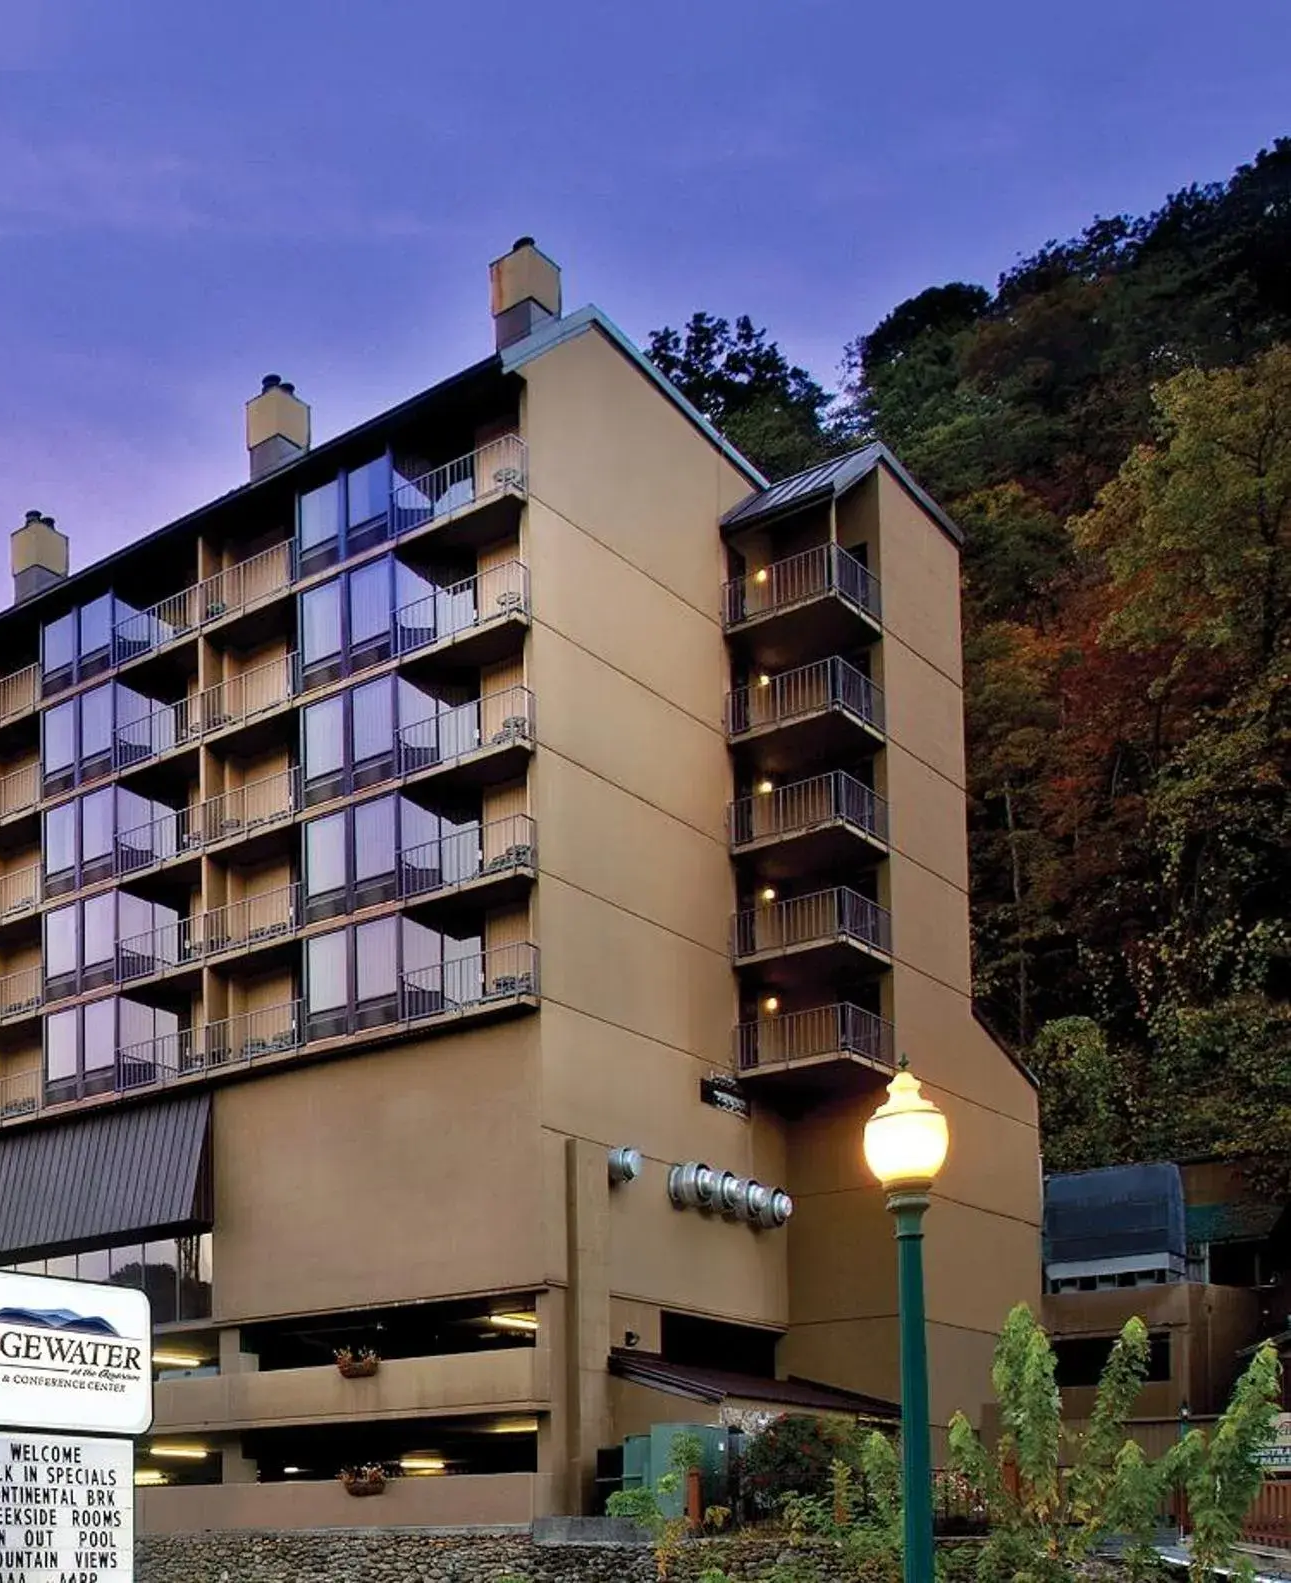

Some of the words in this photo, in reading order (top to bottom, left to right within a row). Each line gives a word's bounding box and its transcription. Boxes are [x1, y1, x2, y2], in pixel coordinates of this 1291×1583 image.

[2, 1375, 10, 1383] &
[13, 1374, 86, 1390] CONFERENCE
[87, 1381, 126, 1393] CENTER
[10, 1443, 81, 1463] WELCOME
[24, 1465, 37, 1482] IN
[46, 1466, 117, 1486] SPECIALS
[87, 1489, 115, 1506] BRK
[72, 1509, 122, 1528] ROOMS
[24, 1529, 54, 1547] OUT
[79, 1531, 117, 1548] POOL
[75, 1551, 117, 1569] VIEWS
